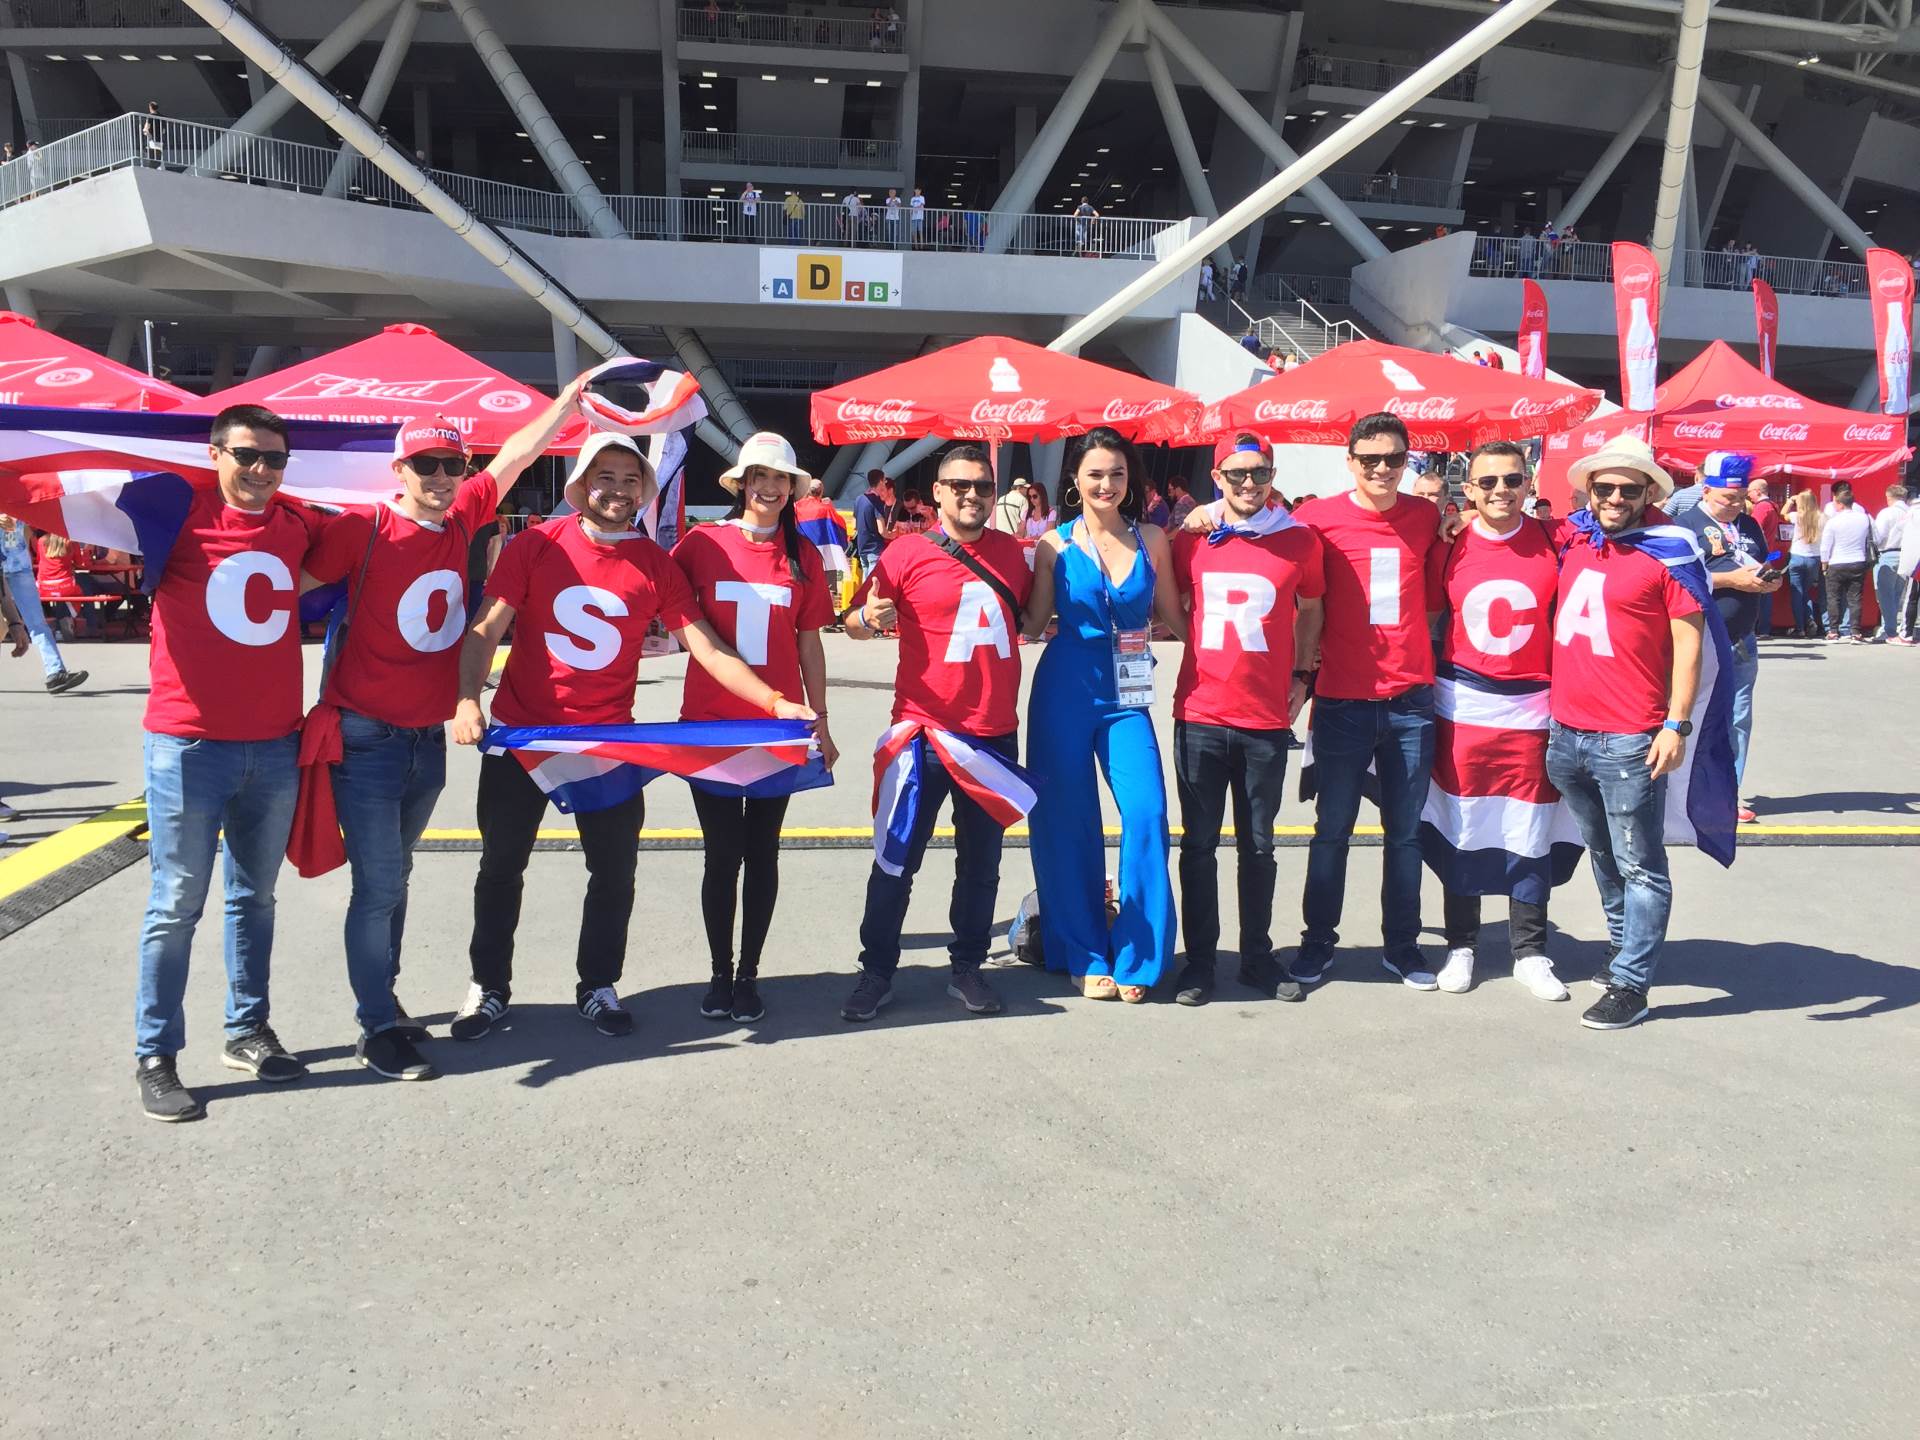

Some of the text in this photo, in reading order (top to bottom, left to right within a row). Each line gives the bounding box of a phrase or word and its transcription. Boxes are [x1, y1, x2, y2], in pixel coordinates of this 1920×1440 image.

[777, 264, 884, 298] A D C B
[314, 377, 439, 398] Bud
[1716, 393, 1804, 410] Coca-Cola
[837, 397, 917, 423] Coca-Cola
[970, 398, 1050, 423] Coca-Cola
[1255, 400, 1329, 421] Coca-Cola
[1383, 396, 1458, 420] Coca-Cola
[1674, 421, 1728, 439] Coca-Cola
[1759, 422, 1810, 441] Coca-Cola
[1843, 423, 1895, 441] Coca-Cola
[206, 551, 294, 646] C
[1369, 547, 1400, 625] I
[397, 569, 466, 652] O
[715, 581, 792, 666] T
[944, 581, 1012, 663] A
[1200, 572, 1277, 652] R
[1461, 579, 1538, 656] C
[1554, 568, 1615, 658] A
[544, 585, 629, 671] S
